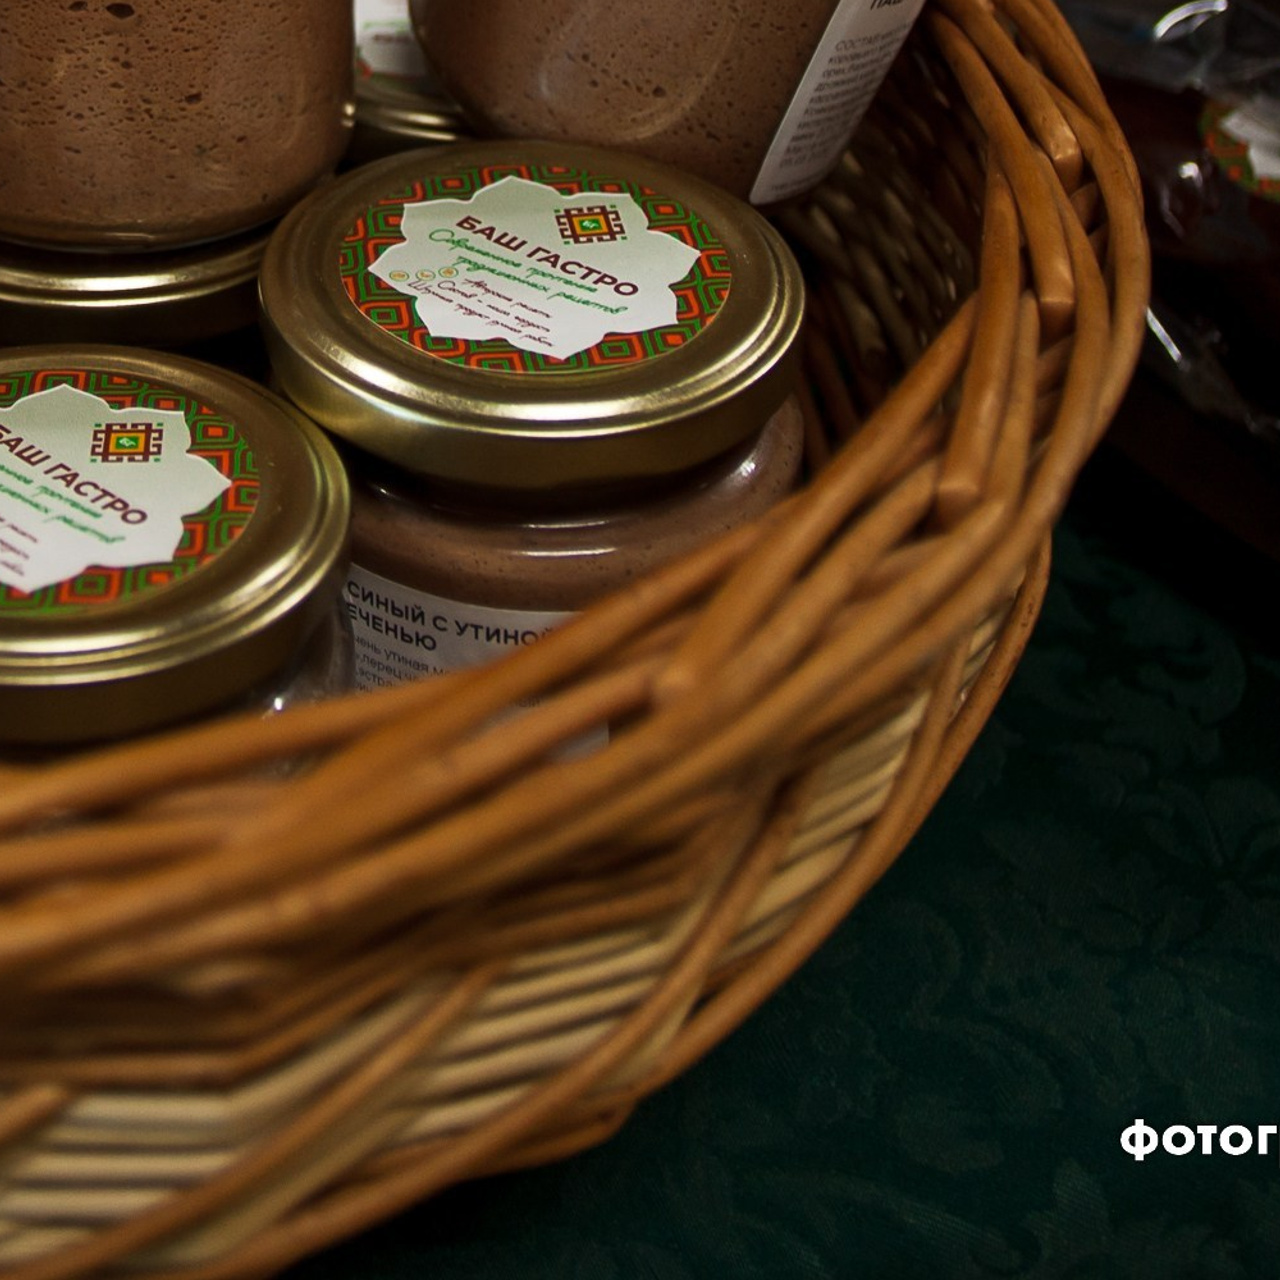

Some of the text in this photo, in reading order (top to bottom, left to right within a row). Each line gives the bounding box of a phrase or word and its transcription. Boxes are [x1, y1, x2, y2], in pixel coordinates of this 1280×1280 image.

[456, 215, 639, 296] БАШ ГАСТРО
[43, 463, 148, 525] ГАСТРО
[346, 601, 437, 651] ЕЧЕНЬЮ
[347, 581, 425, 626] СИНЫЙ
[432, 615, 448, 631] С
